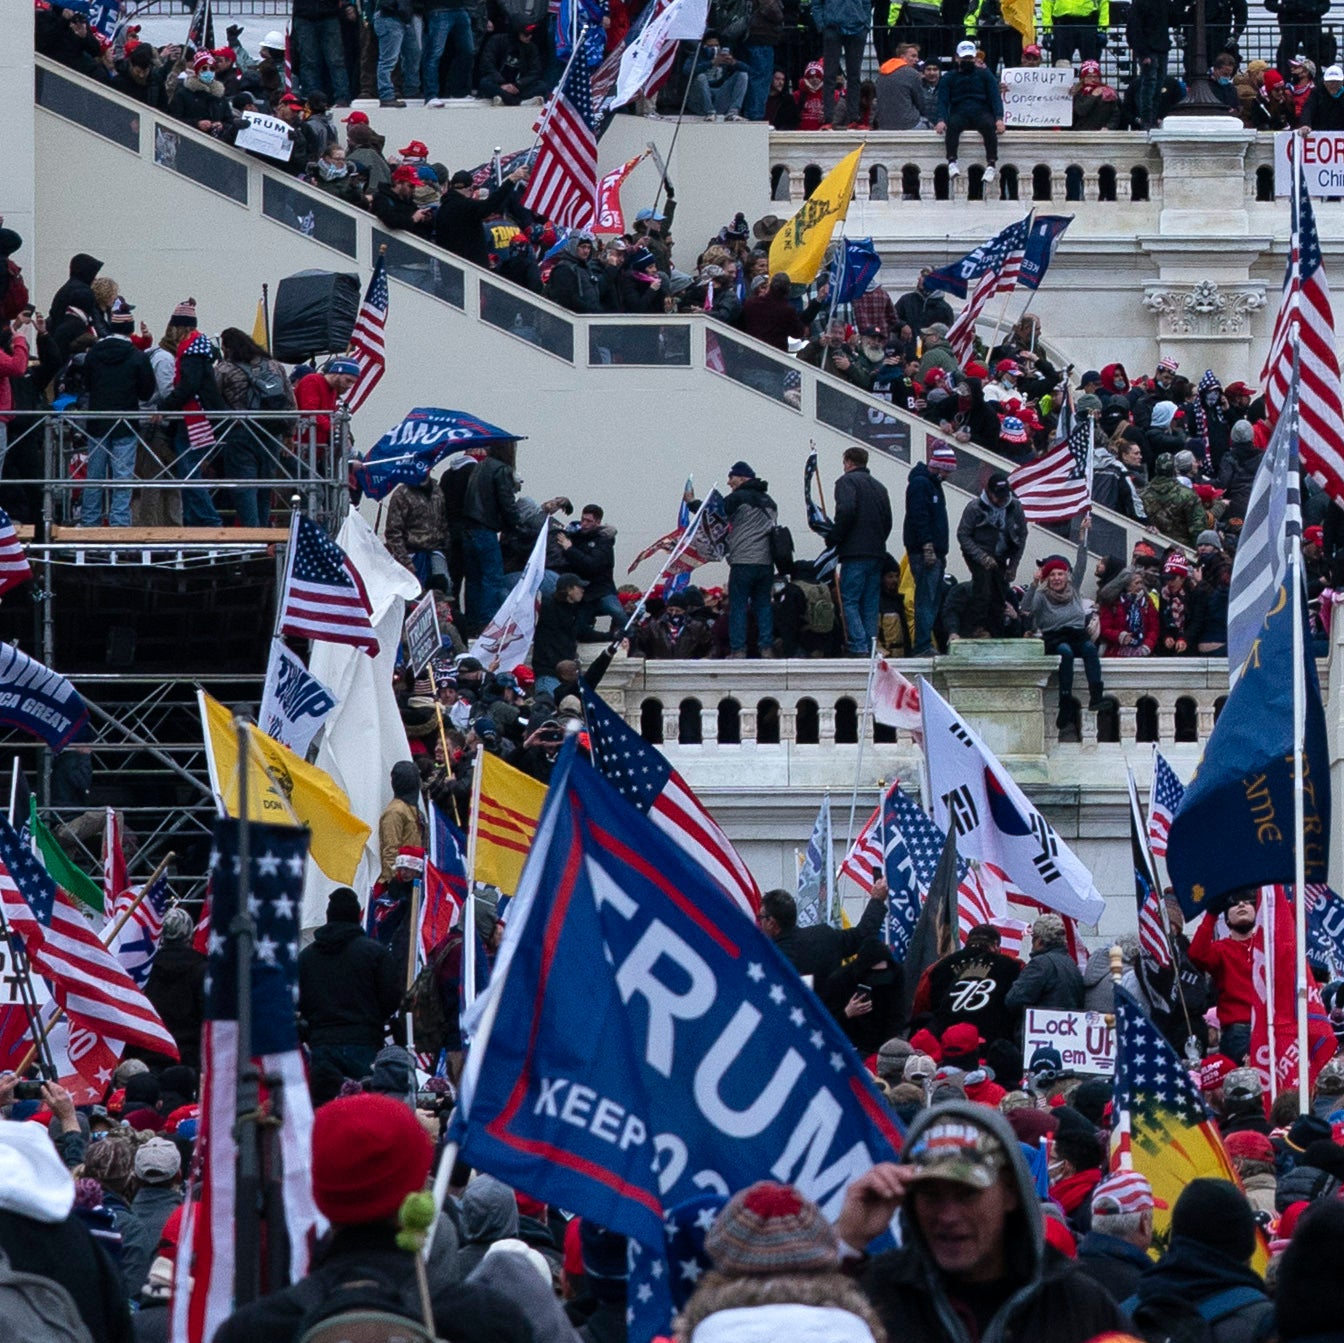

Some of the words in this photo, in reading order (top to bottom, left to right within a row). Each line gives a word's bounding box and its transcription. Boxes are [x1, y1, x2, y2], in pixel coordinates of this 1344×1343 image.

[1003, 71, 1067, 84] CORRUPT
[245, 114, 288, 134] TRUM
[20, 696, 72, 733] GREAT
[1029, 1010, 1079, 1036] Lock
[1028, 1040, 1087, 1065] Tem
[533, 1077, 647, 1151] KEEP
